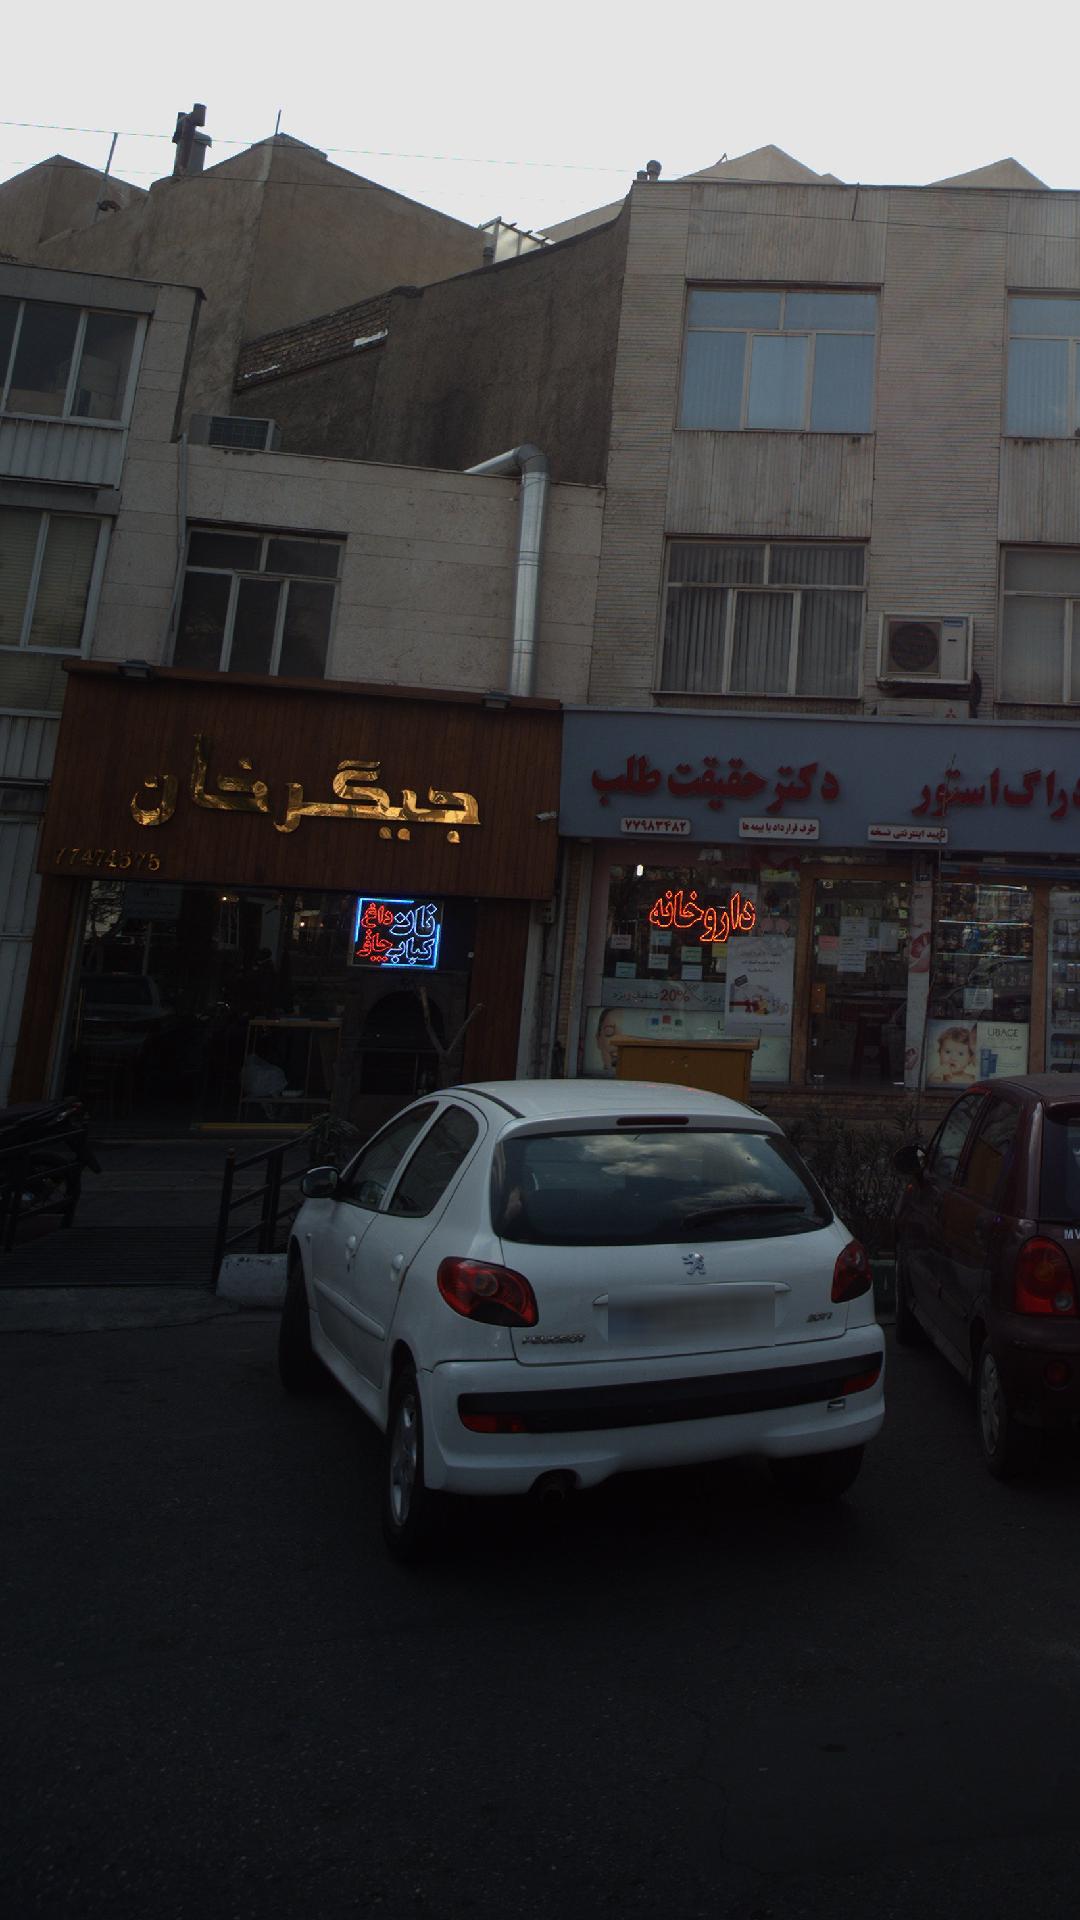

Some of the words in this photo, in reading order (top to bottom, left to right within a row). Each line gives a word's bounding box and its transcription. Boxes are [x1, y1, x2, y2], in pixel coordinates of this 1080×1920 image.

[592, 754, 661, 807] طلب
[667, 756, 768, 810] حقیقت
[766, 763, 839, 814] دکتر
[361, 902, 394, 929] داغ
[389, 903, 438, 937] نان
[649, 888, 757, 942] داروخانه
[385, 937, 436, 964] کباب
